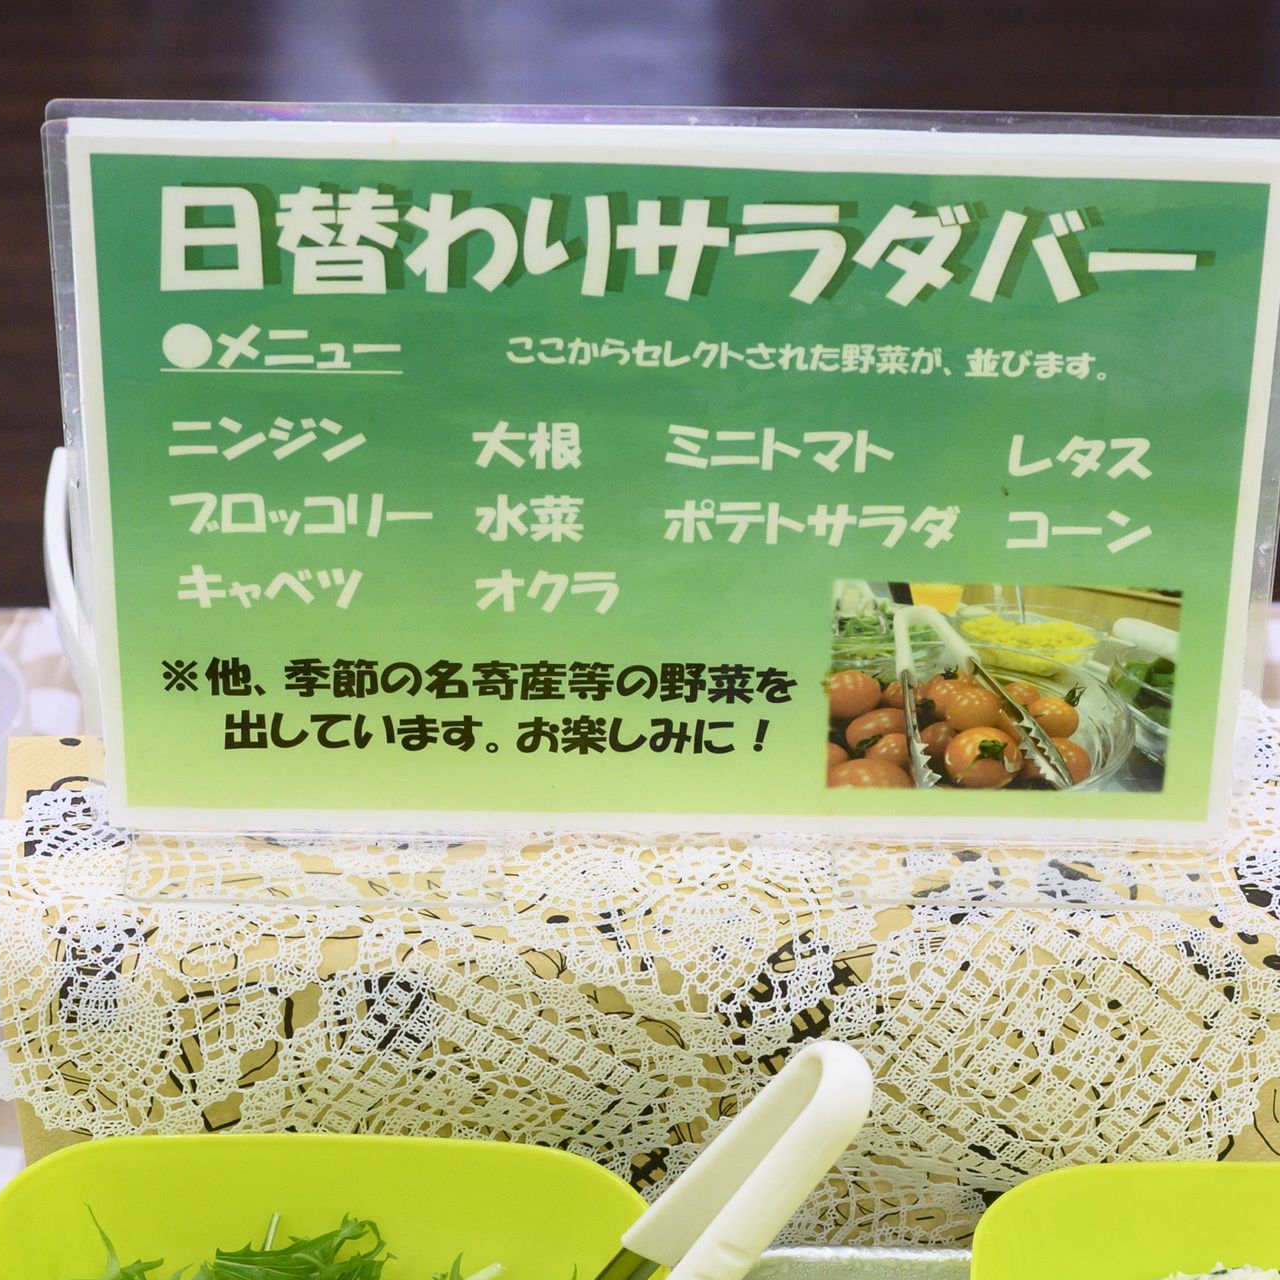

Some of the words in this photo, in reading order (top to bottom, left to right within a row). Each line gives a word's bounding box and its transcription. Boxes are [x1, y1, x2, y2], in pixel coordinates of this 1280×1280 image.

[160, 184, 1202, 306] 日替わりサラダバー
[504, 336, 1109, 381] ここからセレクトされた野菜が、並びます。
[168, 416, 367, 463] ニンジン
[472, 420, 583, 470] 大根
[664, 423, 895, 473] ミニトマト
[1008, 434, 1153, 480] レタス
[169, 492, 433, 538] ブロッコリー
[475, 494, 584, 542] 水菜
[663, 498, 961, 550] ポテトサラダ
[1006, 509, 1153, 554] コーン
[177, 564, 363, 610] キャベツ
[475, 568, 620, 615] オクラ
[161, 656, 798, 704] ※他、季節の名寄産等の野菜を
[224, 709, 772, 755] 出しています。お楽しみに！
